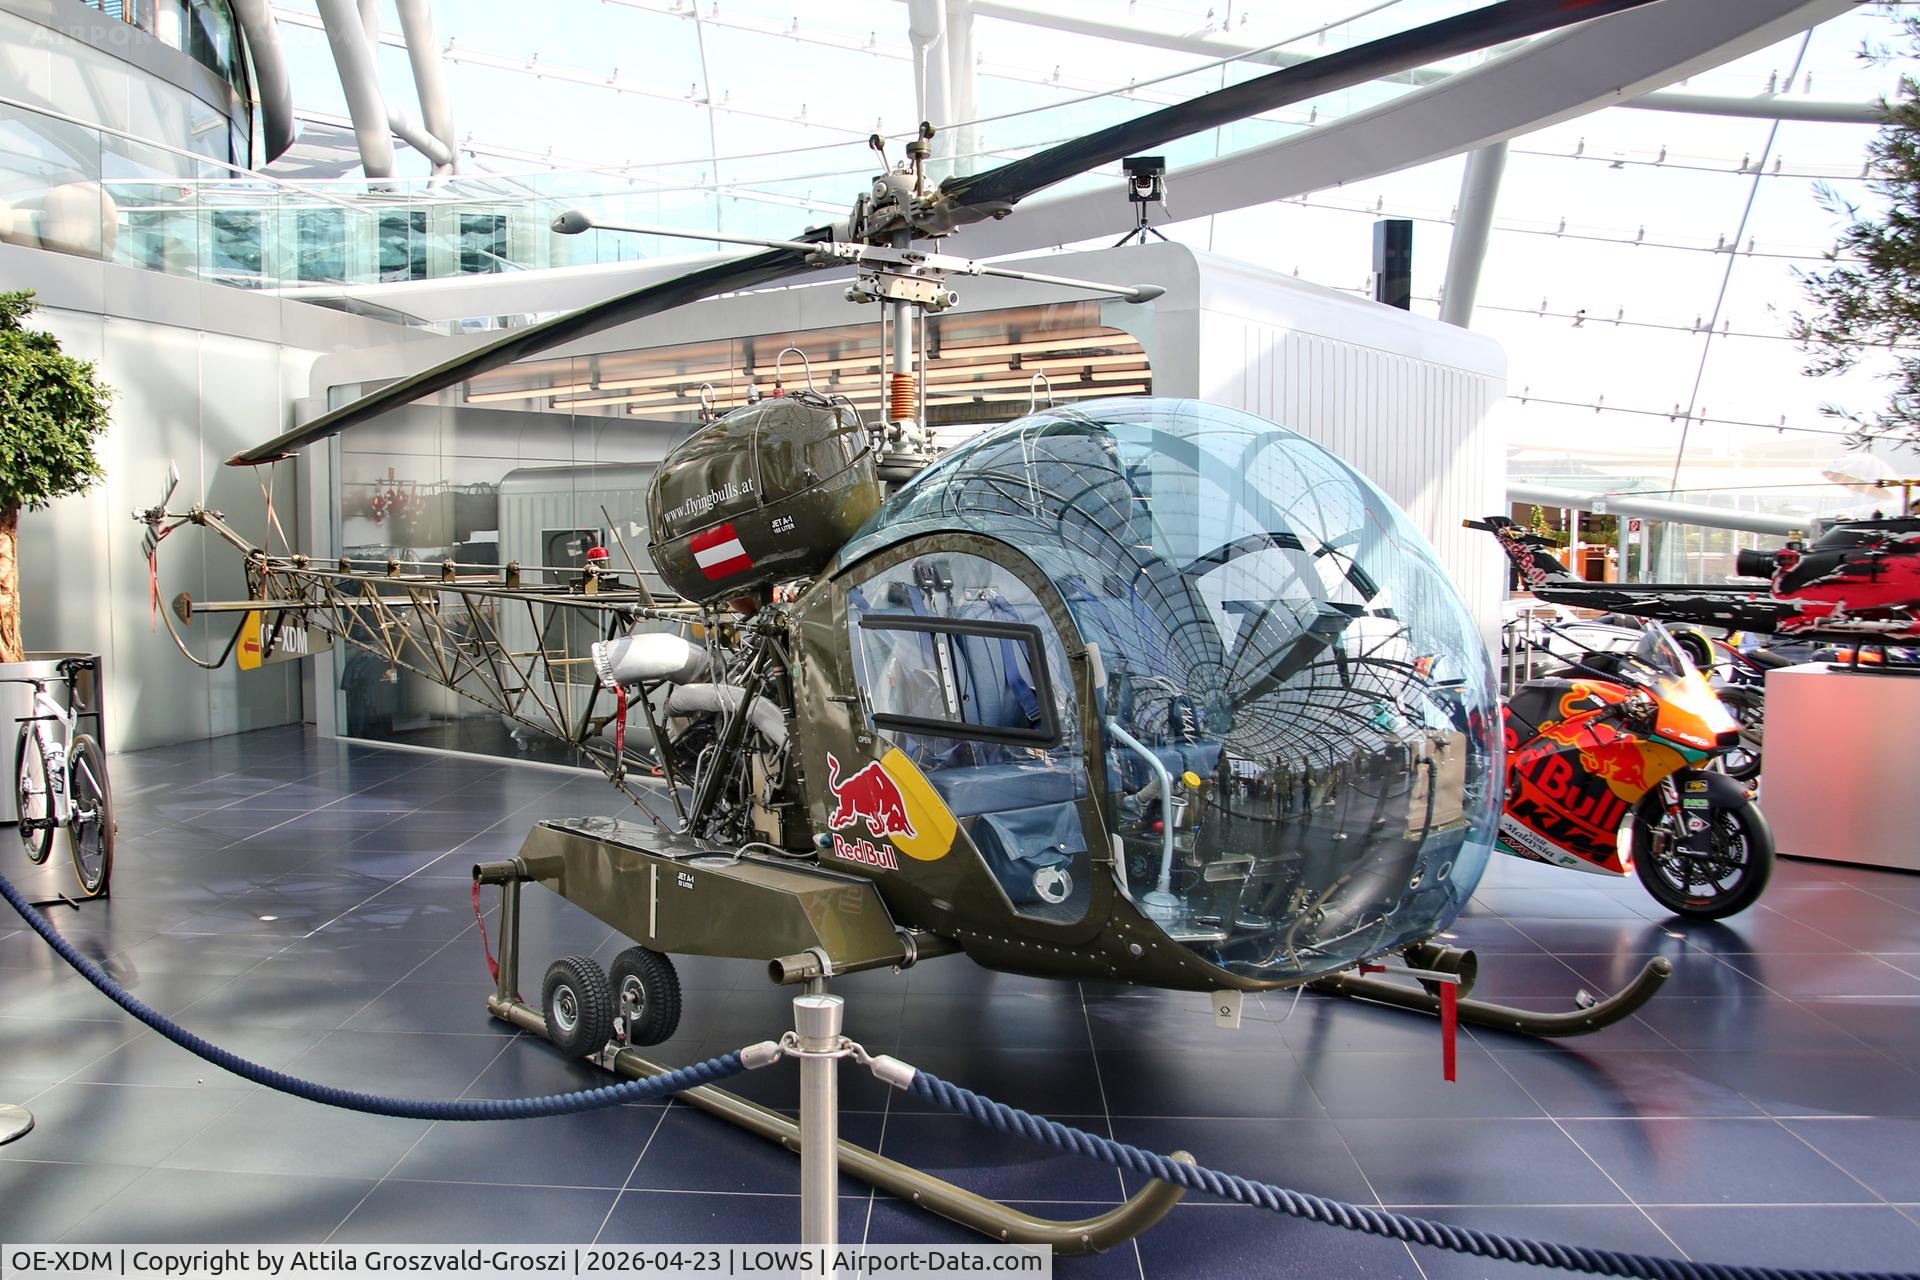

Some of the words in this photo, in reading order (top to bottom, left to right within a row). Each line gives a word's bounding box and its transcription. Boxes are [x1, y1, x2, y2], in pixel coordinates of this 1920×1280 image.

[664, 478, 754, 524] www.flyingbulls.at
[771, 518, 782, 528] JET
[858, 735, 872, 744] OPEN
[1536, 751, 1627, 832] Bull
[1504, 822, 1556, 858] Malaysia
[1511, 797, 1619, 865] KTM
[832, 832, 866, 863] Red
[862, 840, 899, 871] Bull
[678, 871, 687, 881] JET
